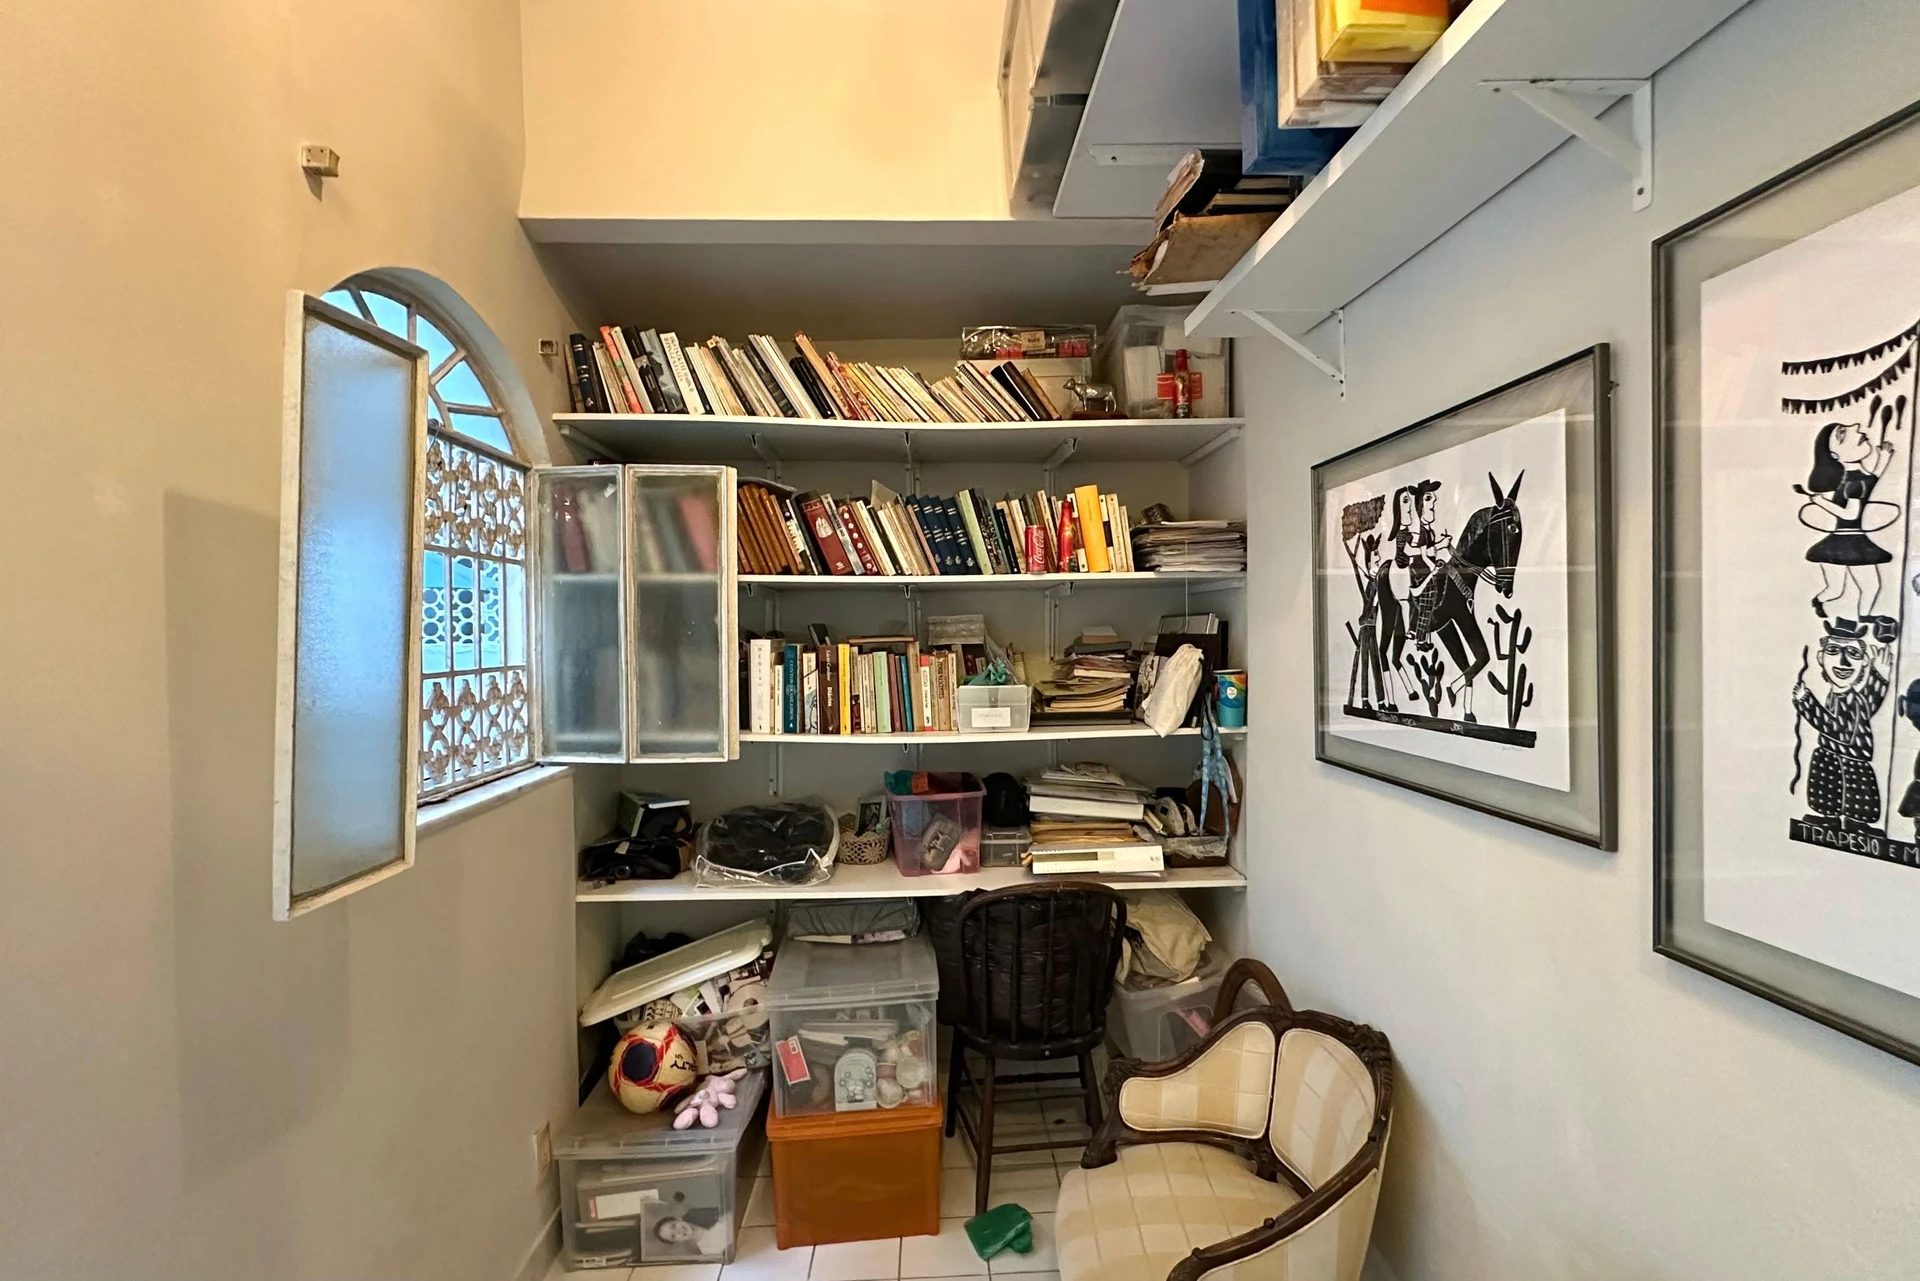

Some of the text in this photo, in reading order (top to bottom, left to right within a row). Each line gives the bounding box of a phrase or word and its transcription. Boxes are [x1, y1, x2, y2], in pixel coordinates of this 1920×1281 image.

[663, 337, 684, 382] STEVEN PINKER
[683, 372, 692, 387] NOVO
[1033, 530, 1045, 564] Coca-Cola
[1798, 823, 1879, 855] TRAPESIO
[1889, 844, 1897, 858] E
